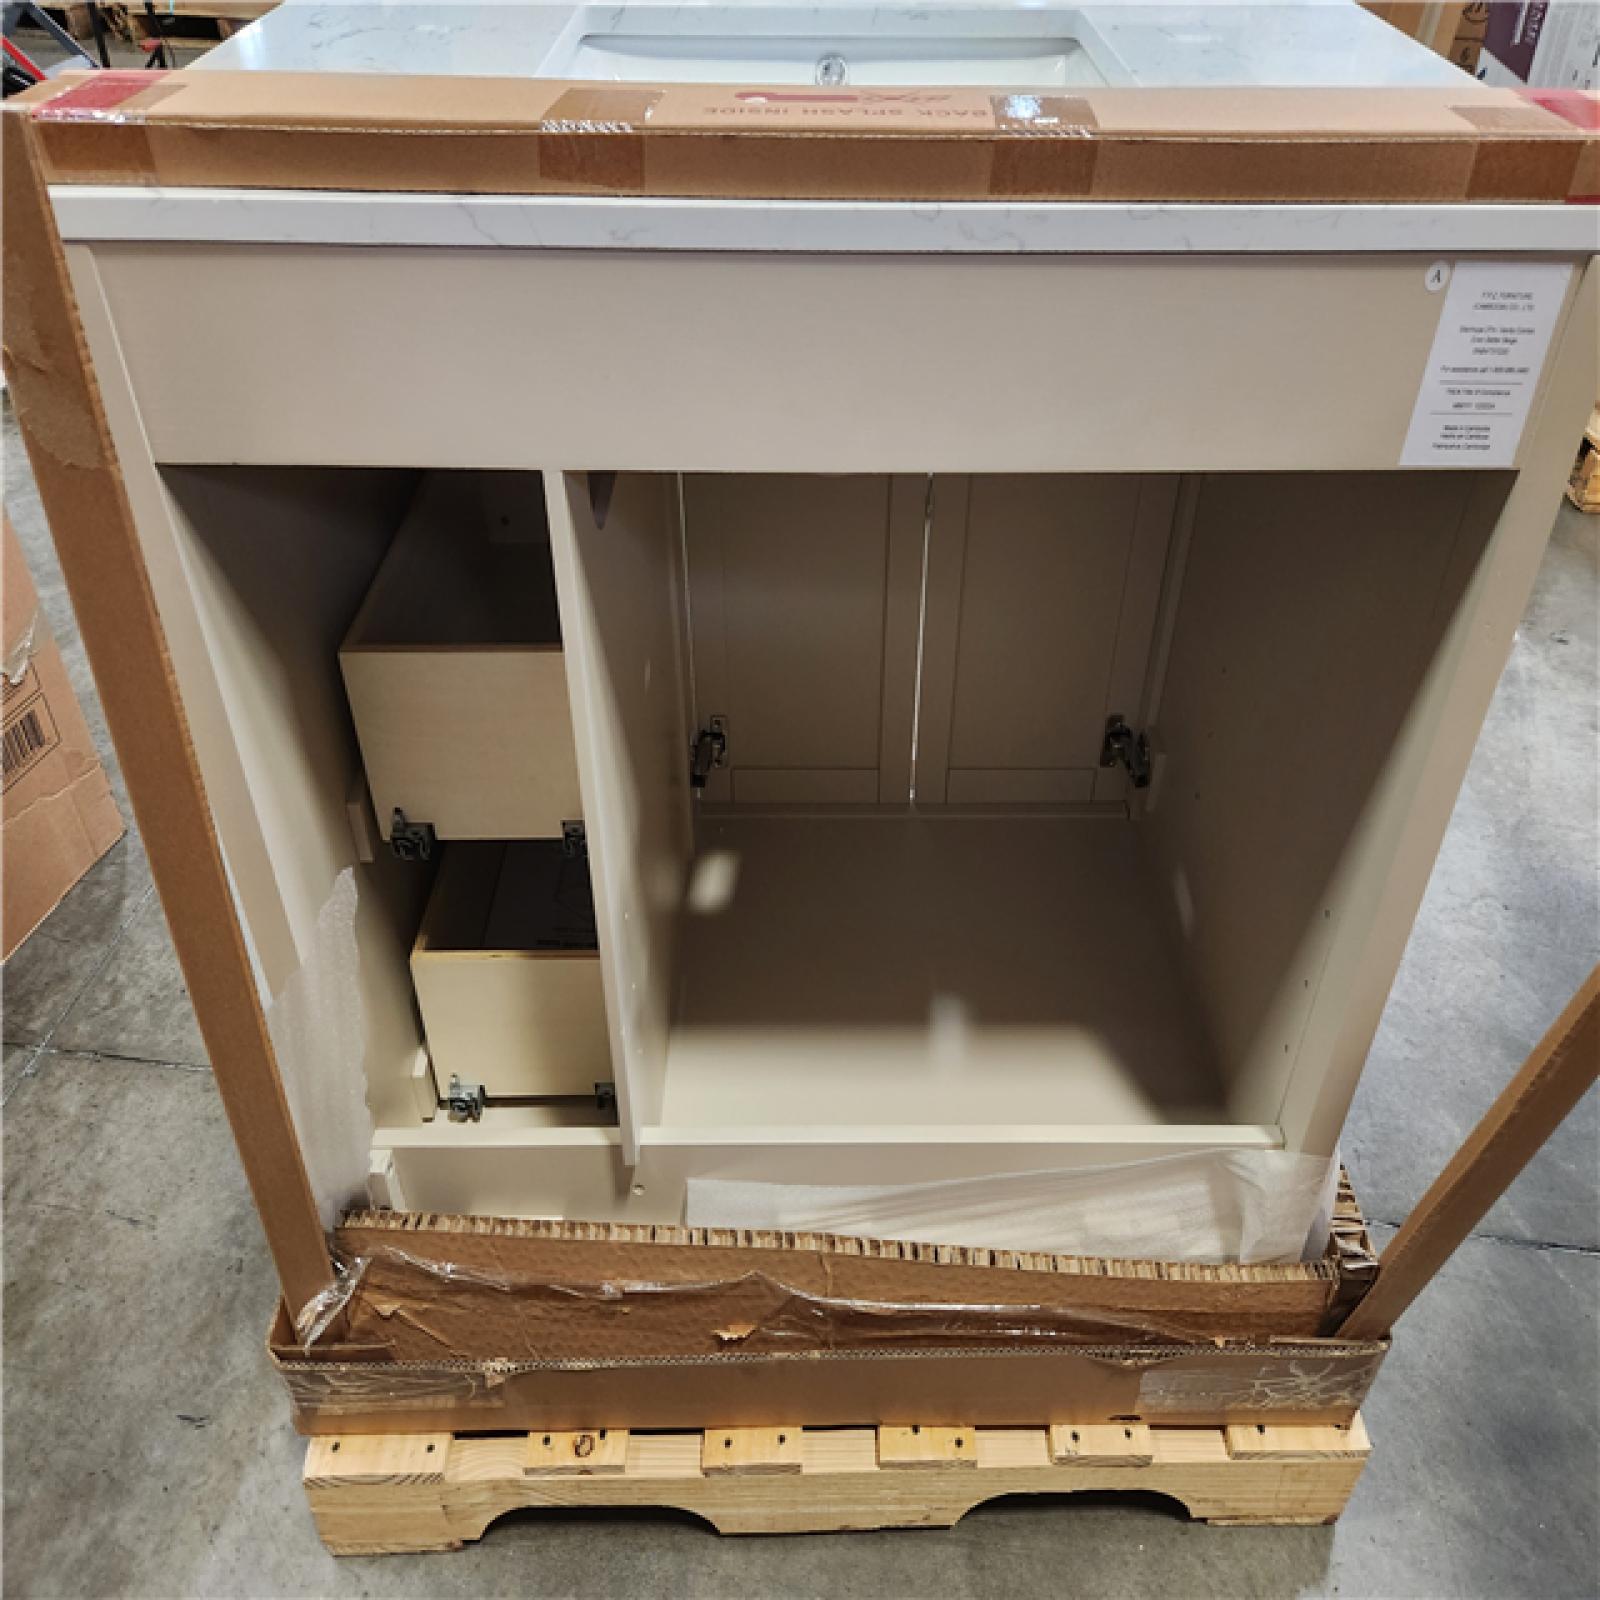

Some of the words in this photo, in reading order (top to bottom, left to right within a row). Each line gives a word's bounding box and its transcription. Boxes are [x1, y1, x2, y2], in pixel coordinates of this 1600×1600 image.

[703, 106, 788, 115] INSIDE
[802, 107, 903, 116] SPLASH
[917, 109, 987, 118] BACK
[1430, 269, 1441, 283] A
